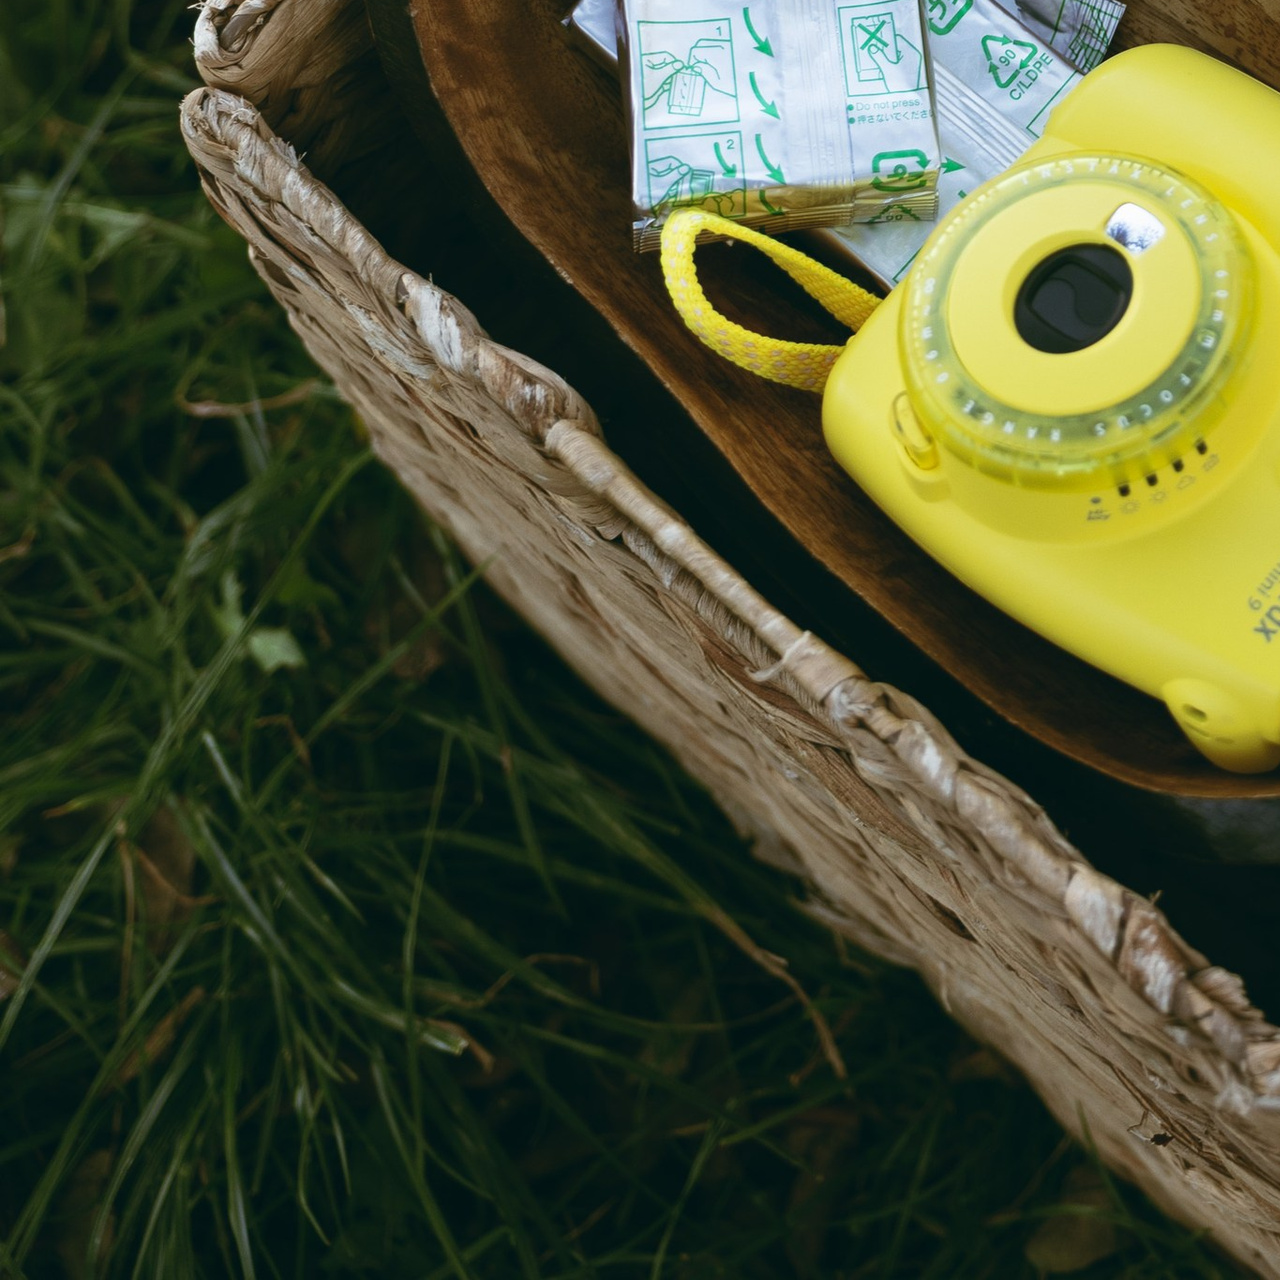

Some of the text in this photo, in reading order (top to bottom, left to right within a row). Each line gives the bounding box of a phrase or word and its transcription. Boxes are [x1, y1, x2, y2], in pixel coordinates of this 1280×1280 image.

[715, 26, 722, 36] 1
[999, 49, 1016, 66] 90
[1009, 52, 1053, 100] C/LDPE
[856, 102, 870, 111] Do
[873, 100, 890, 110] not
[726, 139, 735, 150] 2
[1020, 161, 1144, 186] INSTAX
[1165, 186, 1219, 243] LENS
[1093, 373, 1192, 438] FOCUS
[962, 400, 1062, 444] RANGE
[1247, 596, 1262, 611] 9
